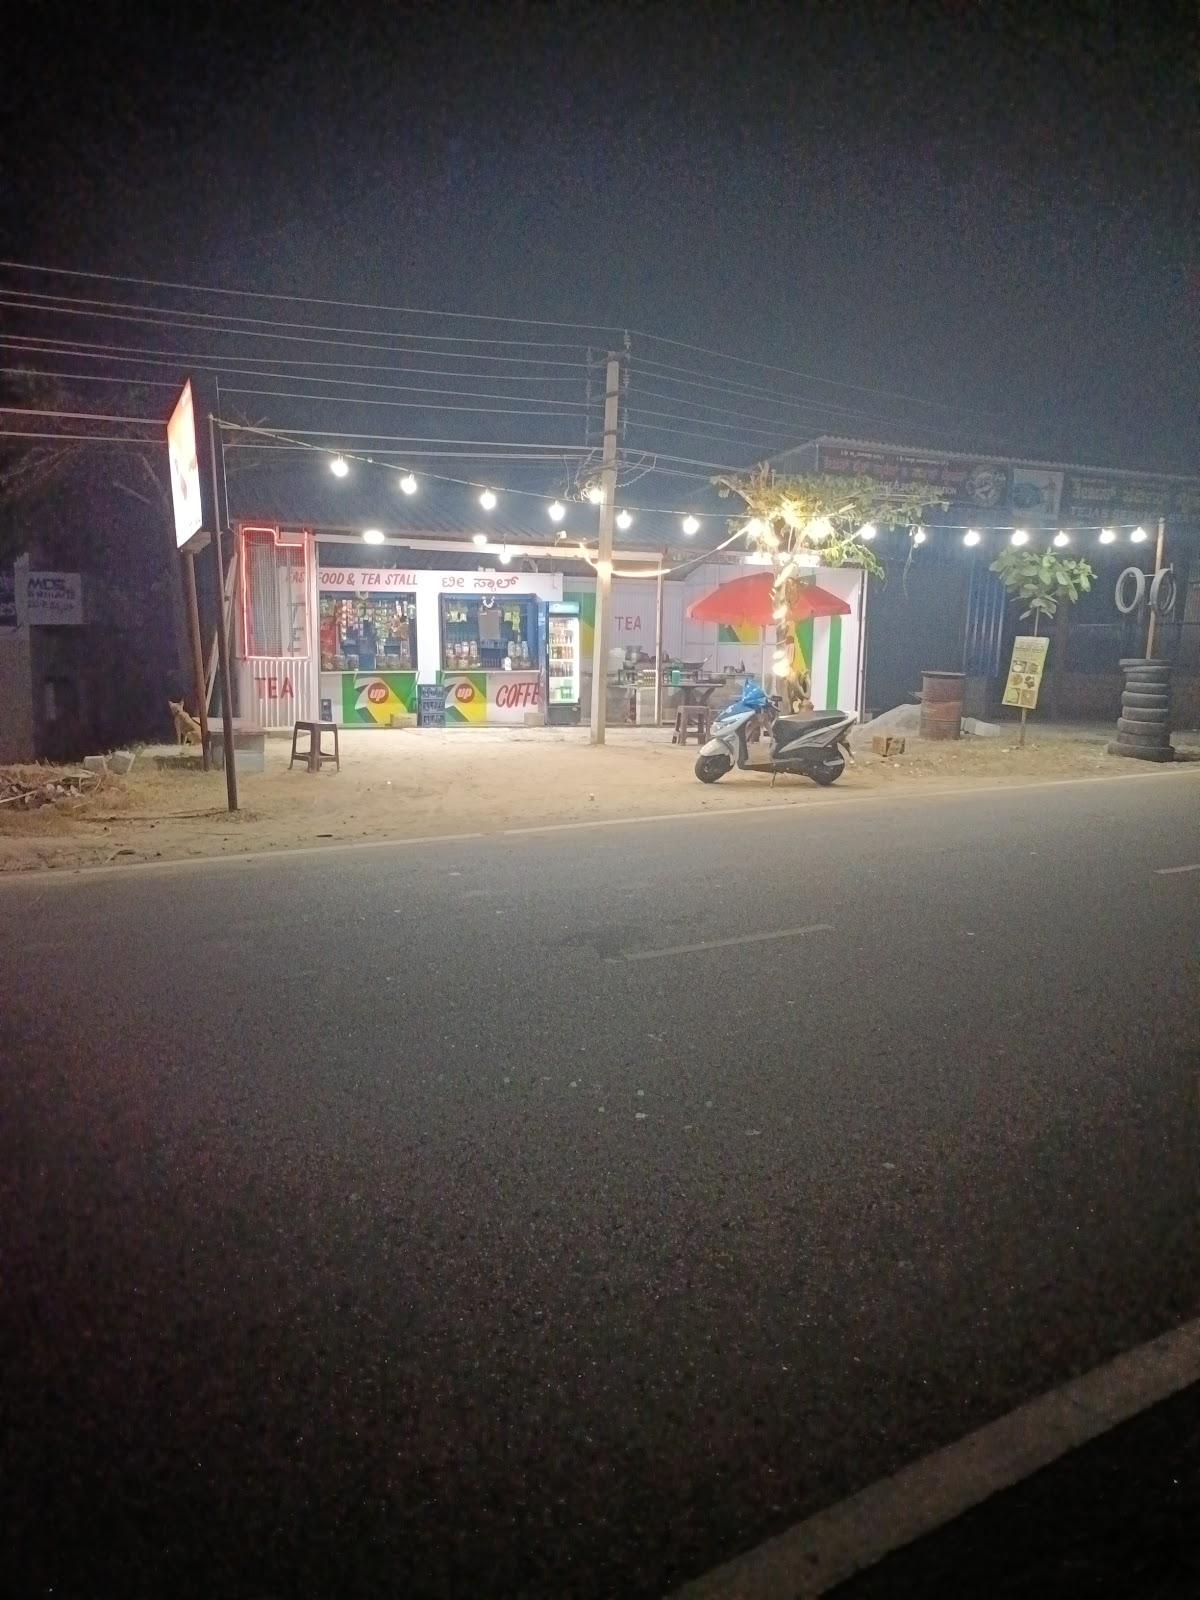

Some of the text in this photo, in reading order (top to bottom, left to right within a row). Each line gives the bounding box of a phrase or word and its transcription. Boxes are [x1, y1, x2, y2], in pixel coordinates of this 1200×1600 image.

[347, 572, 355, 586] &
[361, 573, 380, 585] TEA
[385, 573, 418, 586] STALL
[614, 615, 641, 631] TEA
[254, 677, 294, 699] TEA
[495, 682, 540, 708] COFFE
